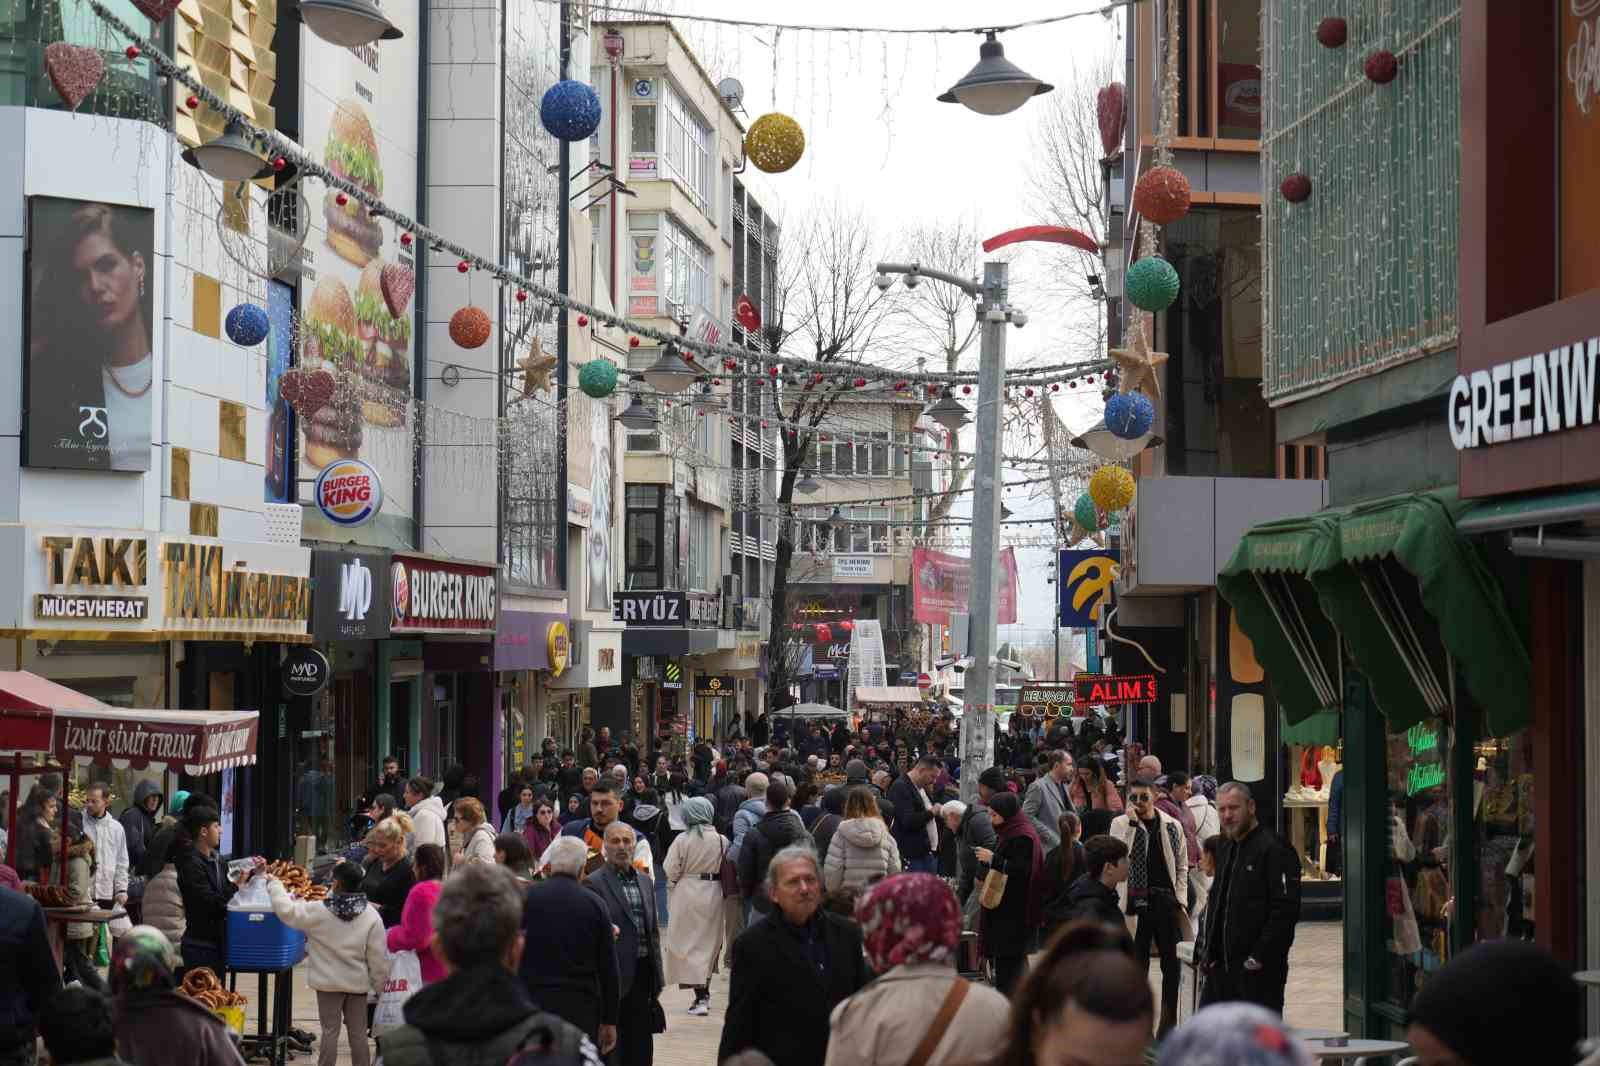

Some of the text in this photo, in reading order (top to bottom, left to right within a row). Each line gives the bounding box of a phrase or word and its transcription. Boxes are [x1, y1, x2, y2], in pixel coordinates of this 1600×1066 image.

[1448, 336, 1600, 450] GREENW
[323, 475, 370, 492] BURGER
[323, 486, 371, 507] KING
[42, 536, 147, 586] TAKI
[412, 570, 463, 619] BURGER
[466, 575, 495, 620] KING
[42, 596, 144, 618] MÜCEVHERAT
[827, 642, 850, 658] McC
[1090, 681, 1141, 700] ALIM
[64, 721, 197, 759] İZMİT SİMİT FIRINI
